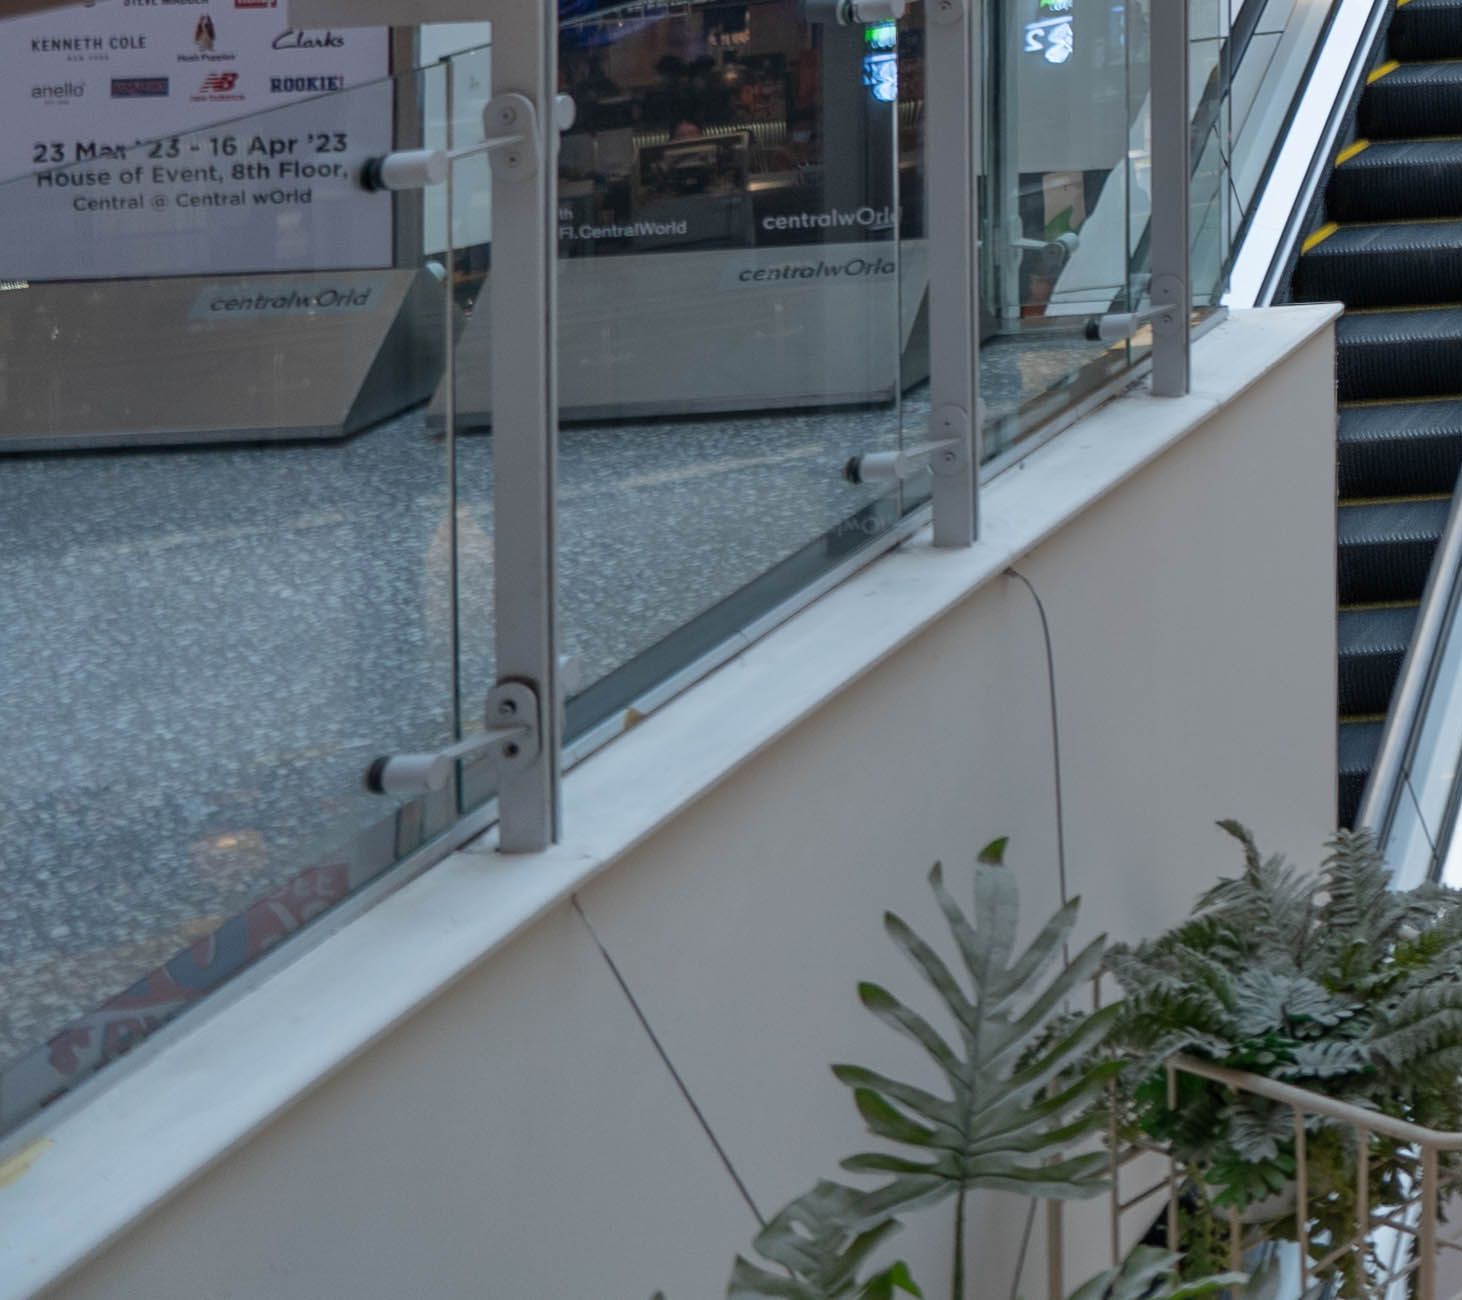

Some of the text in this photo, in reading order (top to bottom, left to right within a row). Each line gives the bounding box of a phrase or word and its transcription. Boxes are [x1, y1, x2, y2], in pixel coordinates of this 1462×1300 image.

[31, 35, 147, 53] KENNETH COLE
[271, 31, 345, 51] Clarks
[33, 144, 65, 164] 23
[75, 142, 128, 163] Mar
[209, 137, 238, 157] 16
[249, 135, 298, 158] Apr
[37, 159, 349, 188] House of Event, 8th Floor,
[73, 194, 145, 212] Central
[176, 190, 246, 209] Central
[252, 188, 313, 206] wOrld
